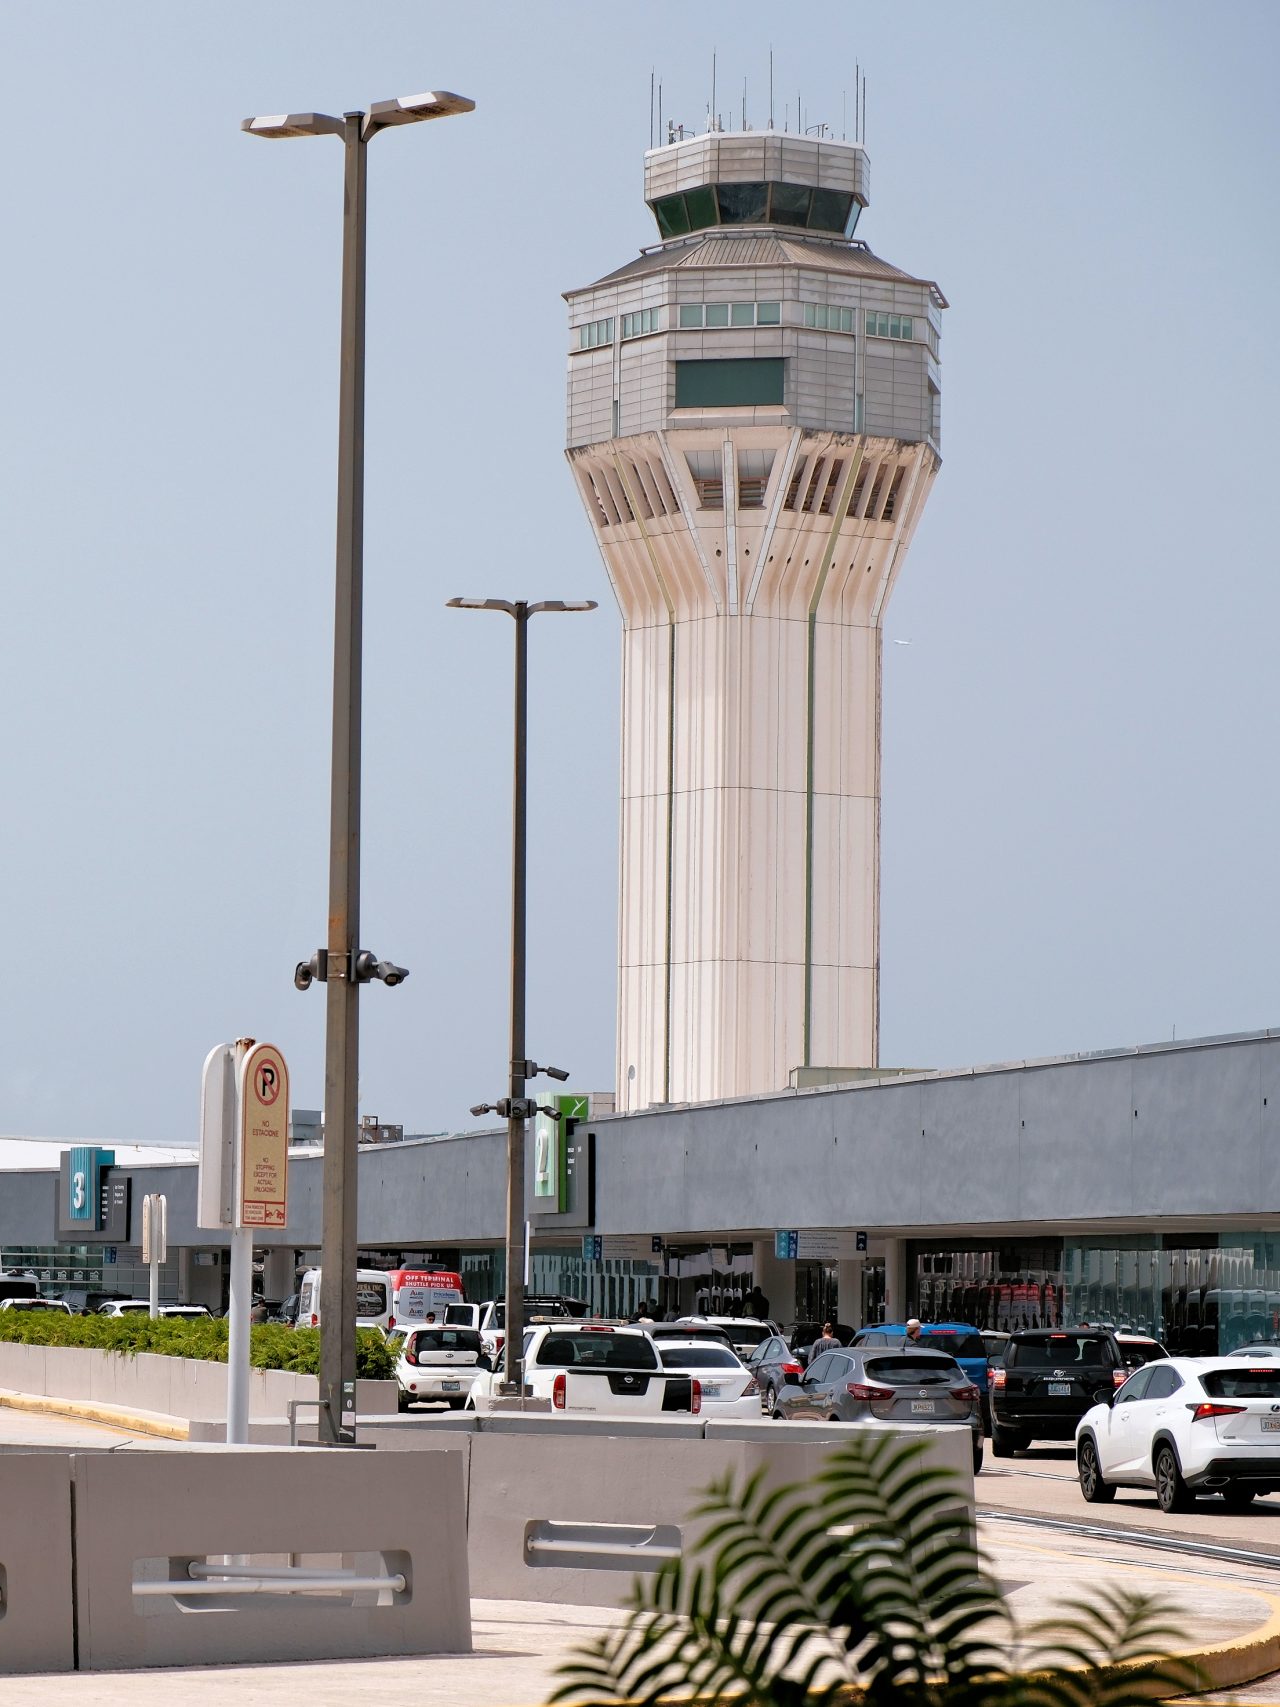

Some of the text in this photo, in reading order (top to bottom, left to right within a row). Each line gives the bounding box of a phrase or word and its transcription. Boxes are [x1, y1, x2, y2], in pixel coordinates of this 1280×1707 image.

[261, 1120, 270, 1128] NO
[252, 1129, 280, 1138] ESTACIONE
[536, 1128, 549, 1182] 2
[73, 1171, 85, 1209] 3
[420, 1275, 454, 1283] TERMINAL
